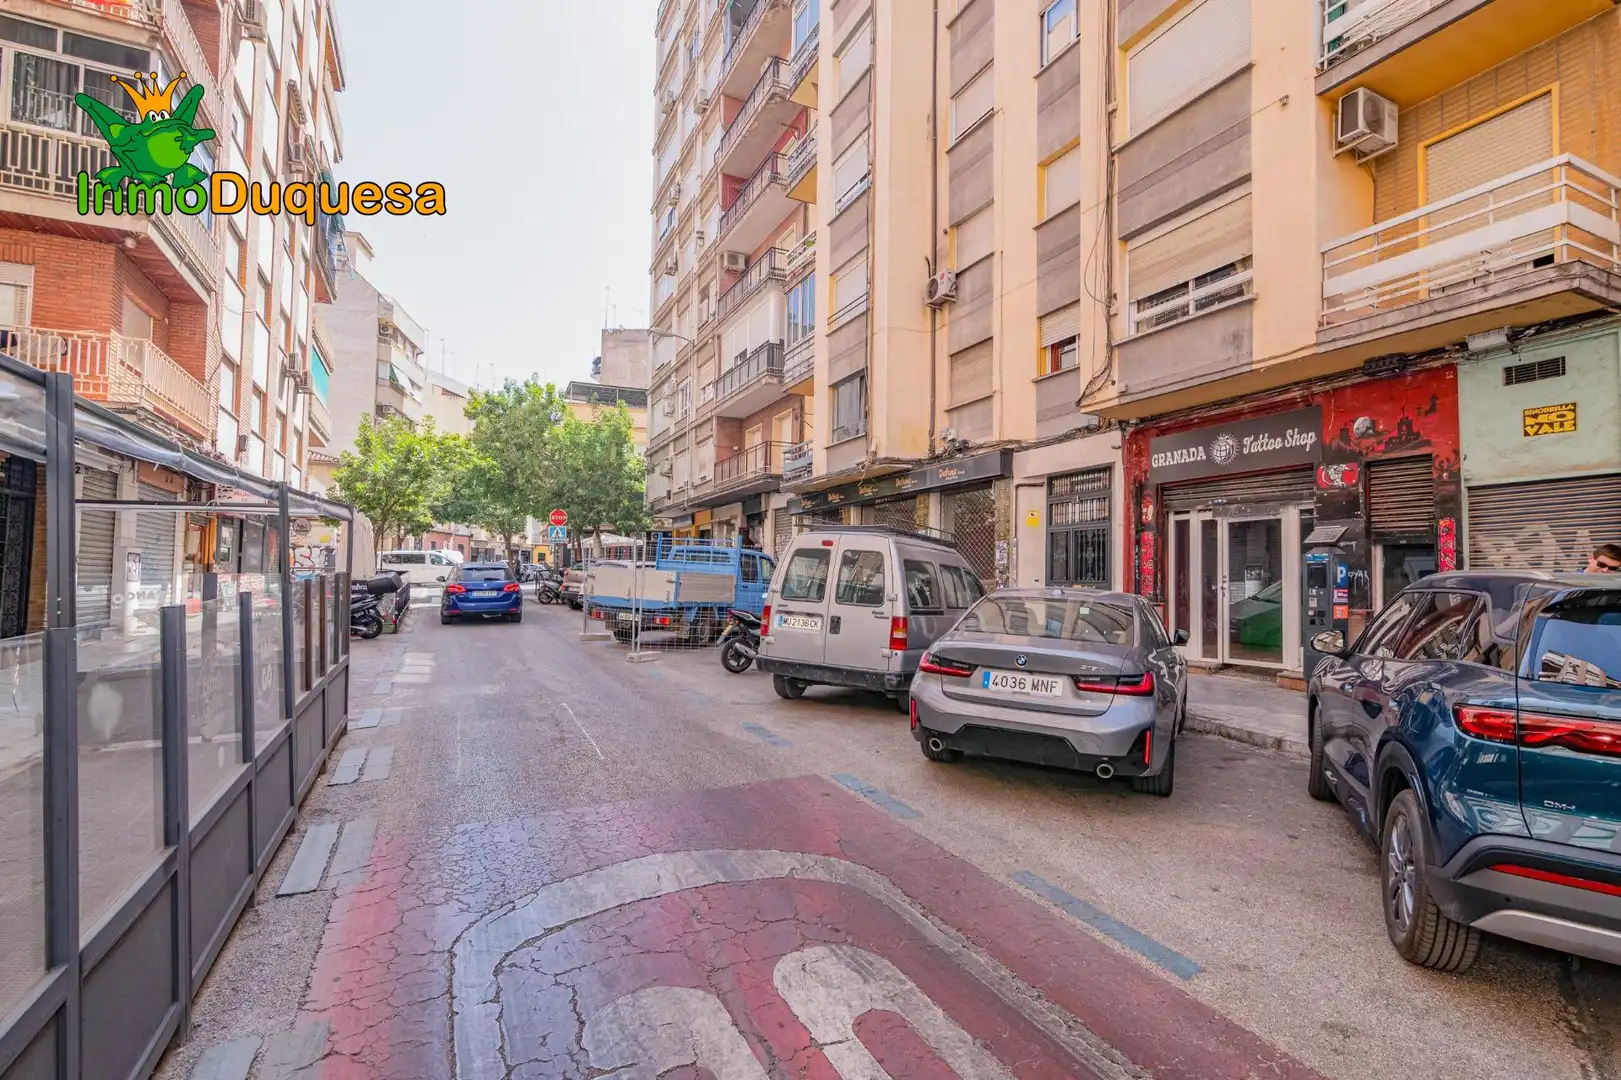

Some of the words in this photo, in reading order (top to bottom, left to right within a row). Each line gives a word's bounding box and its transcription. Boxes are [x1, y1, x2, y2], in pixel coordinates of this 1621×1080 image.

[1525, 411, 1575, 425] NO
[1525, 420, 1575, 436] VALE
[1151, 446, 1207, 468] GRANADA
[1242, 432, 1284, 455] Tattoo
[1284, 427, 1318, 452] Shop
[1336, 565, 1347, 584] P
[992, 674, 1027, 690] 4036
[1030, 677, 1059, 694] MNF
